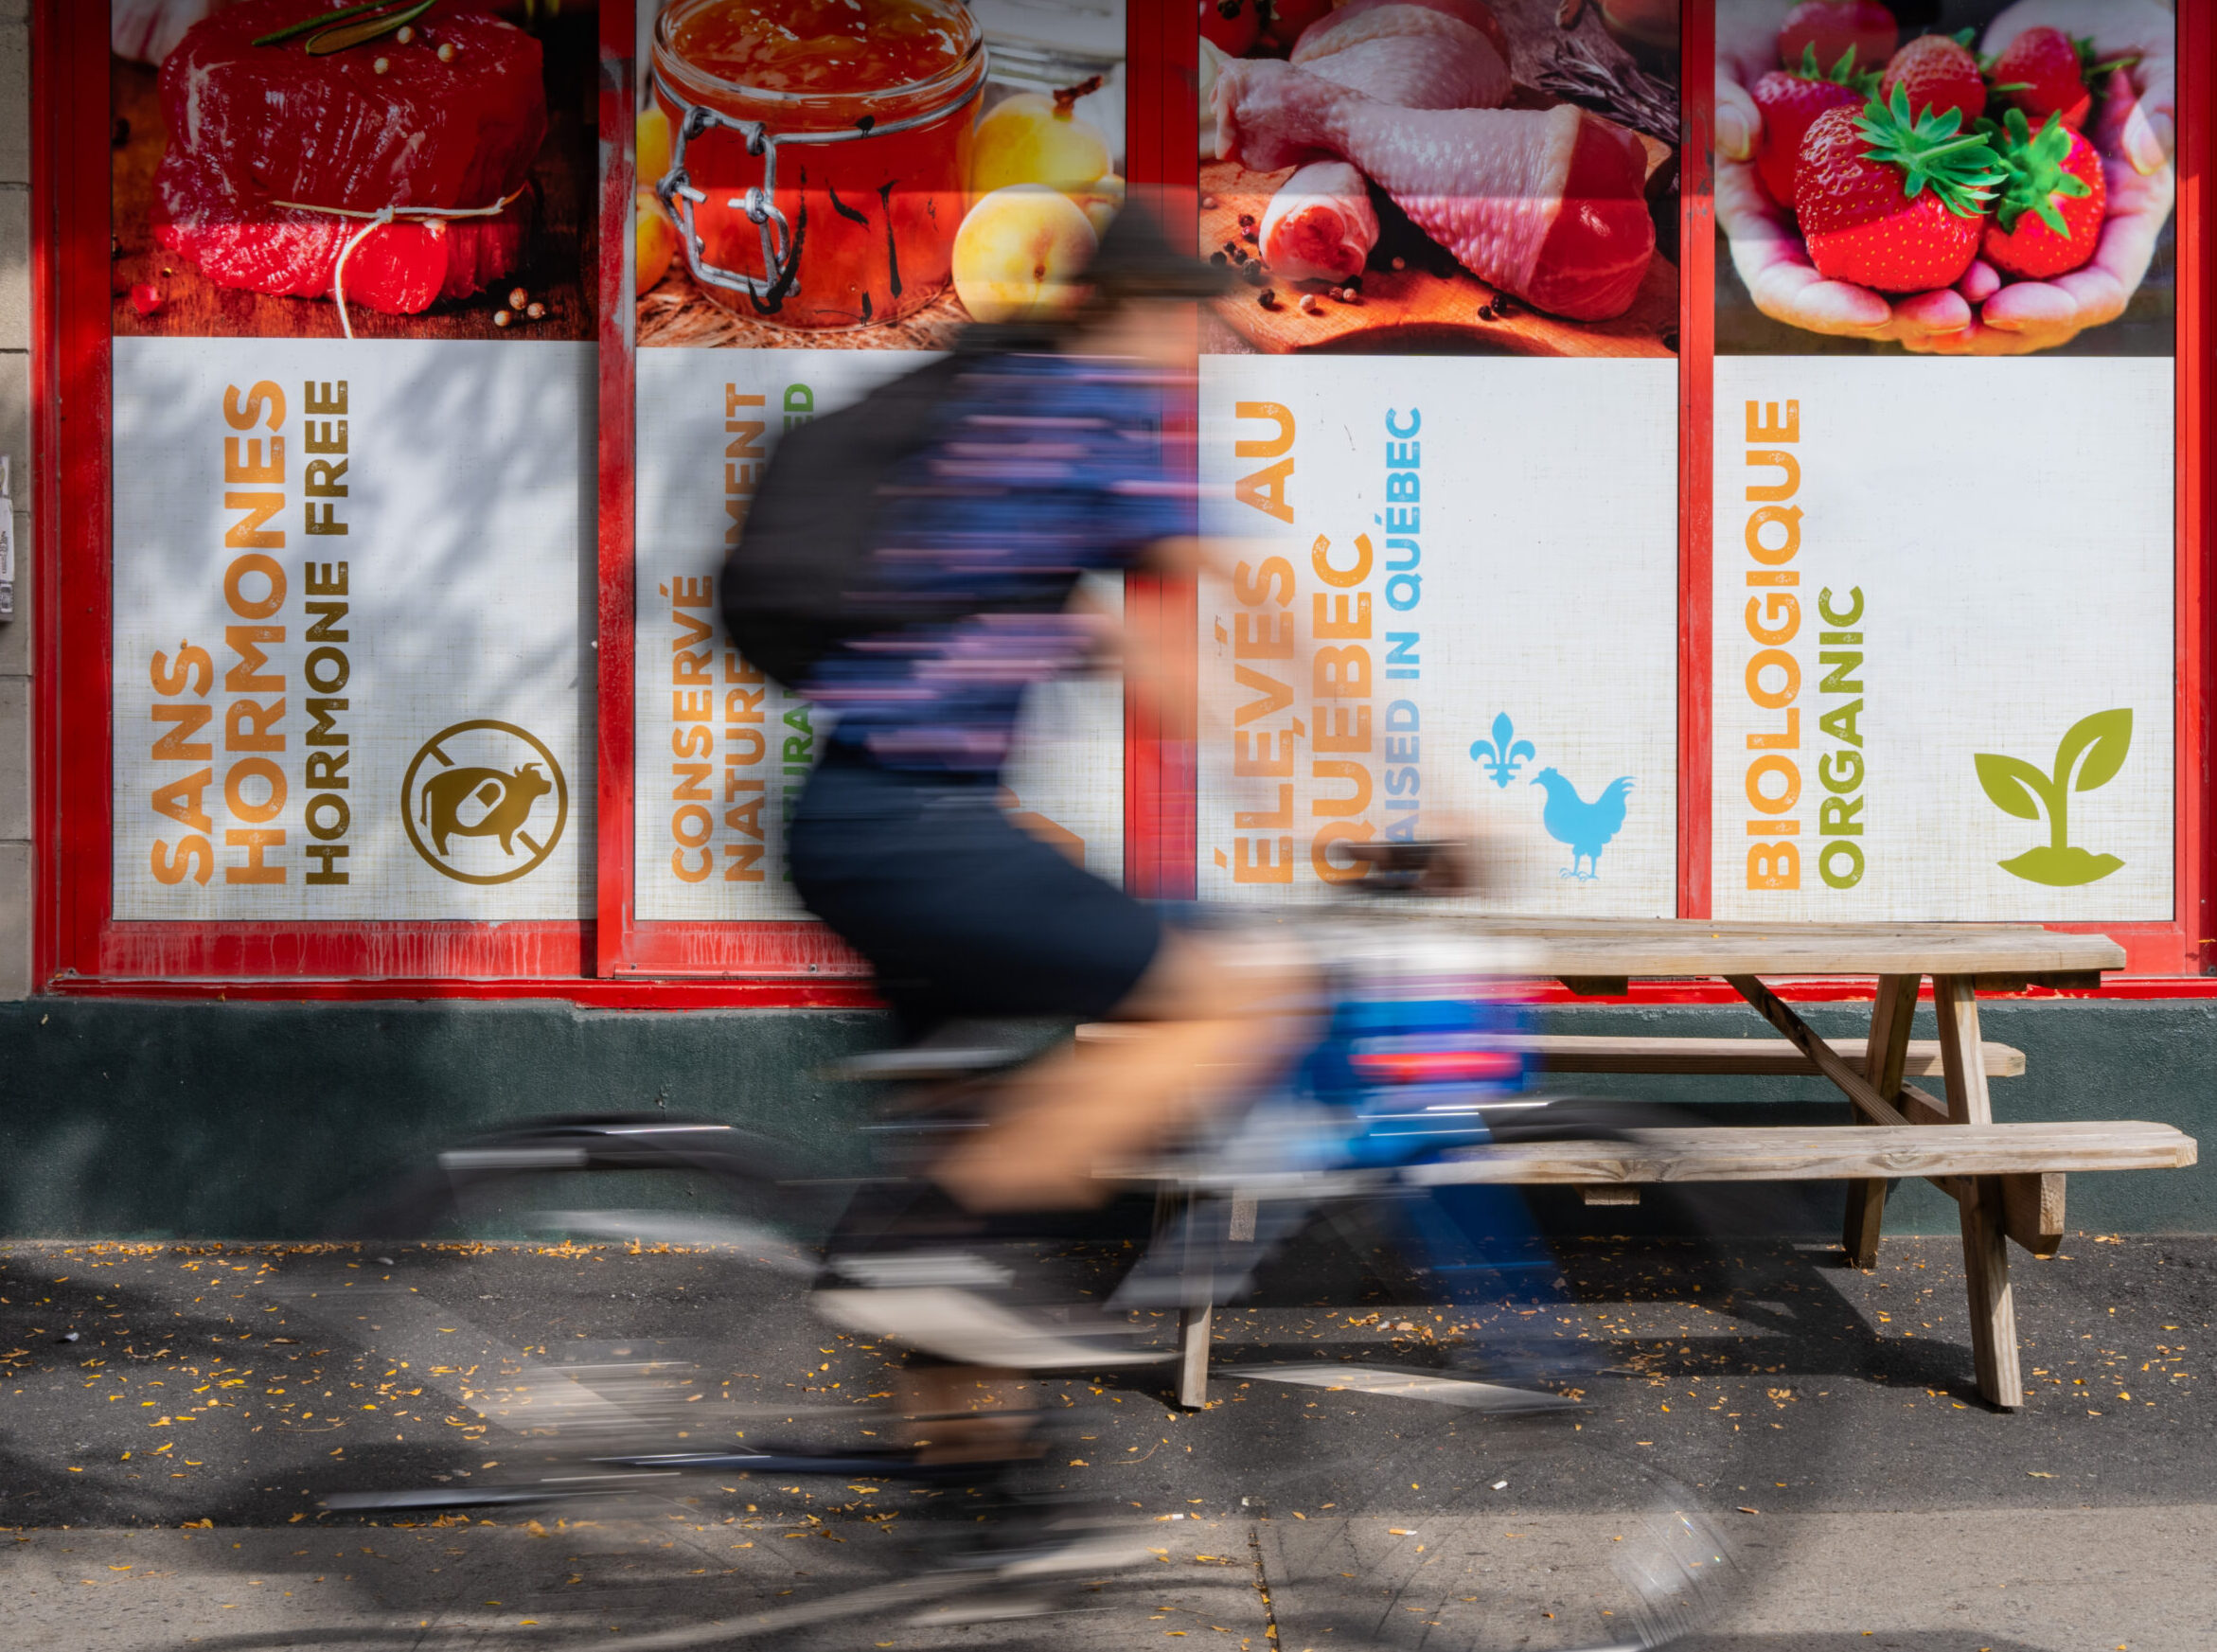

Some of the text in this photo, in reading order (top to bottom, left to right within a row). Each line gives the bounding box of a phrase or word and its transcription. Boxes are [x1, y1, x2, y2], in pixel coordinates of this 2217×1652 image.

[151, 646, 214, 887] SANS
[223, 380, 288, 885] HORMONES
[305, 380, 350, 885] HORMONE FREE
[659, 575, 714, 883] CONSERVÉ
[1214, 401, 1296, 884] ÉLEVÉS AU
[1291, 532, 1377, 886] QUÉBEC
[1375, 407, 1423, 882] AISED IN QUÉBEC
[1745, 399, 1804, 891] BIOLOGIQUE
[1818, 585, 1865, 890] ORGANIC
